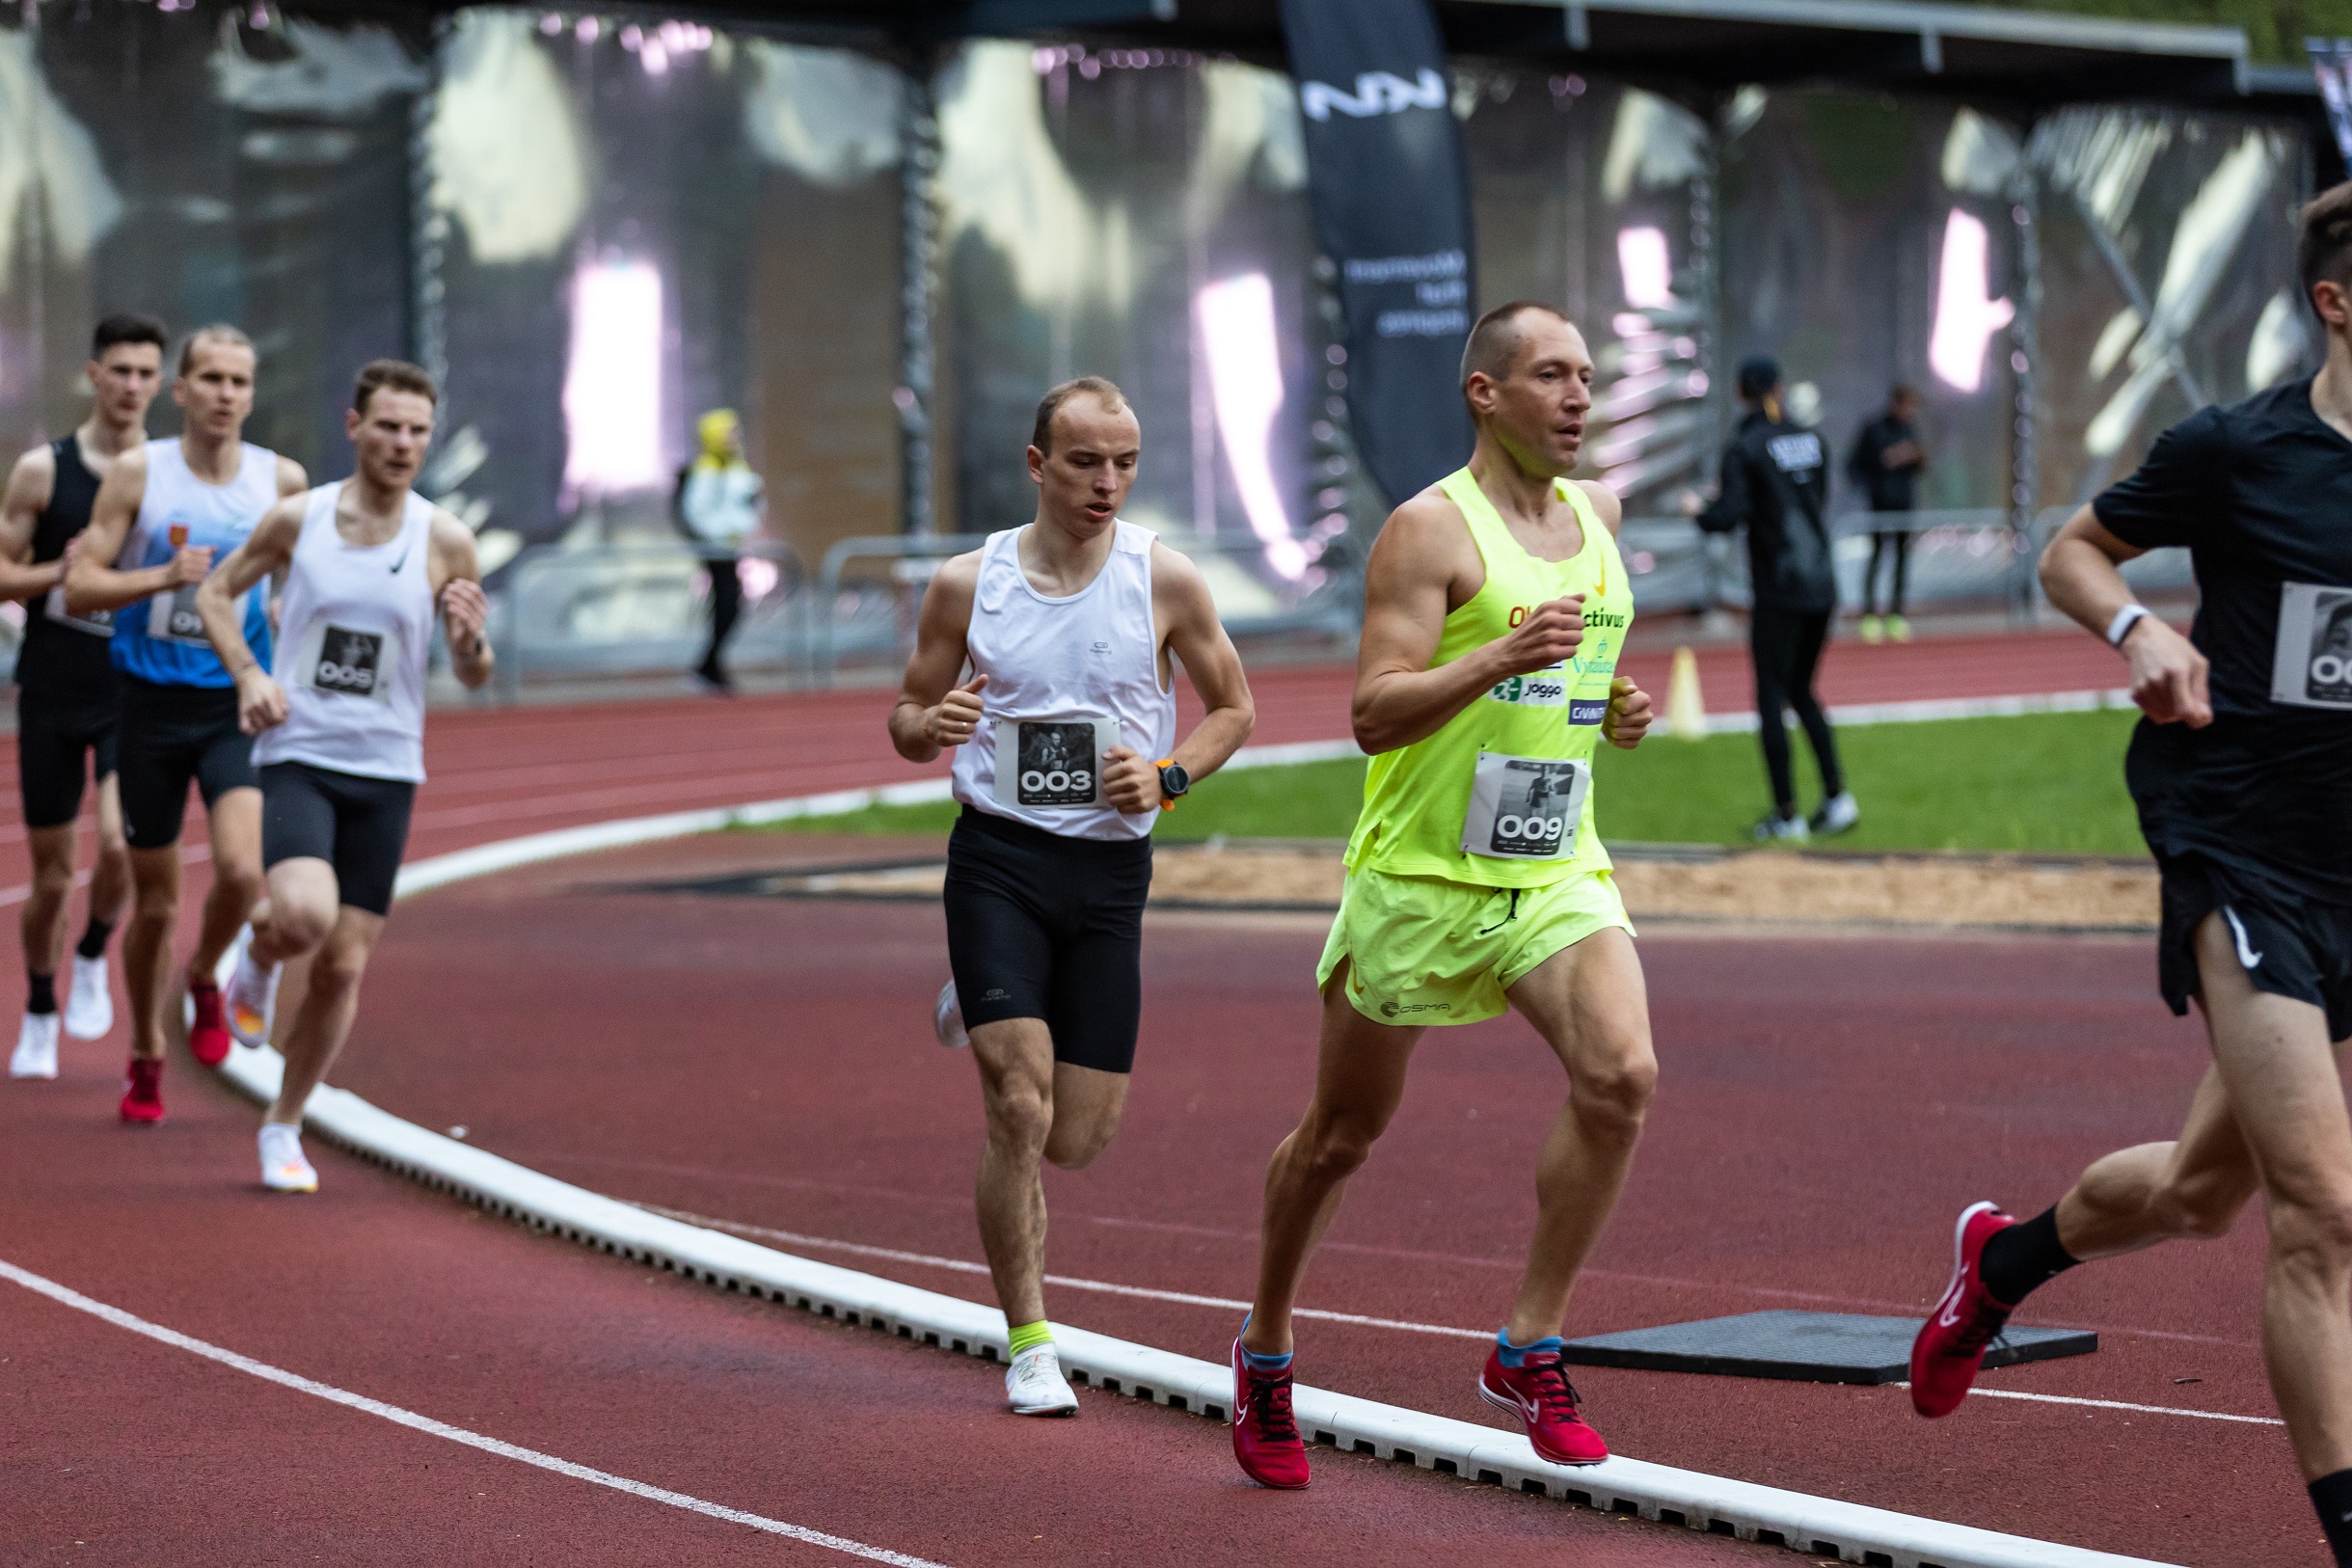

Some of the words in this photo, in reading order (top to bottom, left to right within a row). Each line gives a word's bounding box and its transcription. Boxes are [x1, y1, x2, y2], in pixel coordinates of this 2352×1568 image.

[1584, 607, 1625, 628] ctivus
[2311, 655, 2352, 685] 0
[1021, 770, 1092, 792] 003
[1497, 814, 1562, 841] 009
